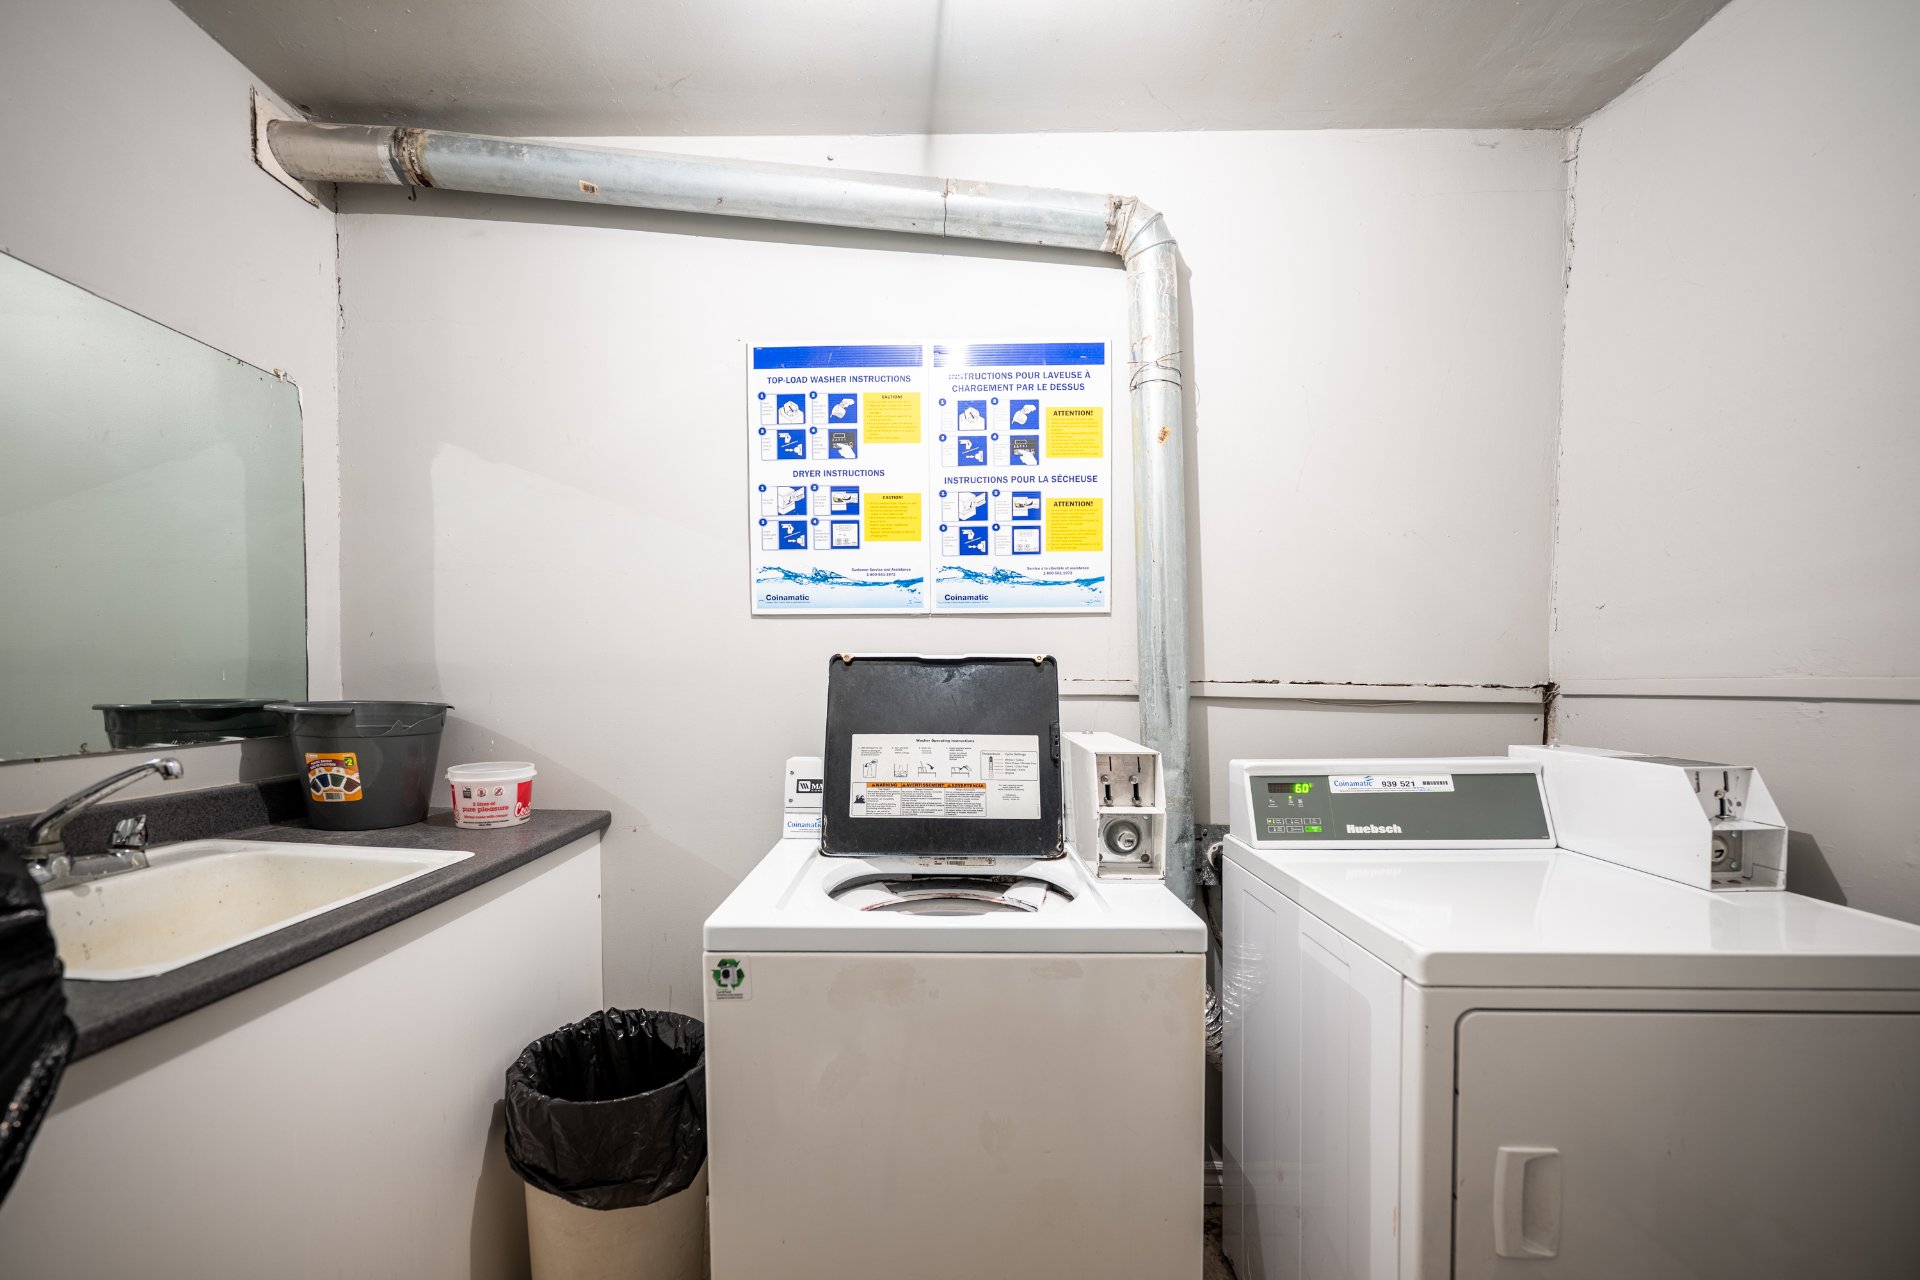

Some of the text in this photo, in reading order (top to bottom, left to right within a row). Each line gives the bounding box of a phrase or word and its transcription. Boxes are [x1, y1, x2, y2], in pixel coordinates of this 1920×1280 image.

[948, 369, 1091, 380] TRUCTIONS POUR LAVEUSE À
[767, 375, 912, 384] TOP-LOAD WASHER INSTRUCTIONS
[952, 383, 1085, 392] CHARGEMENT PAR LE DESSUS
[792, 469, 885, 478] DRYER INSTRUCTIONS
[944, 476, 1008, 484] INSTRUCTIONS
[1038, 475, 1049, 483] LA
[1051, 473, 1098, 483] SÉCHEUSE
[477, 805, 509, 813] pleasure
[1346, 824, 1403, 833] Huebsch
